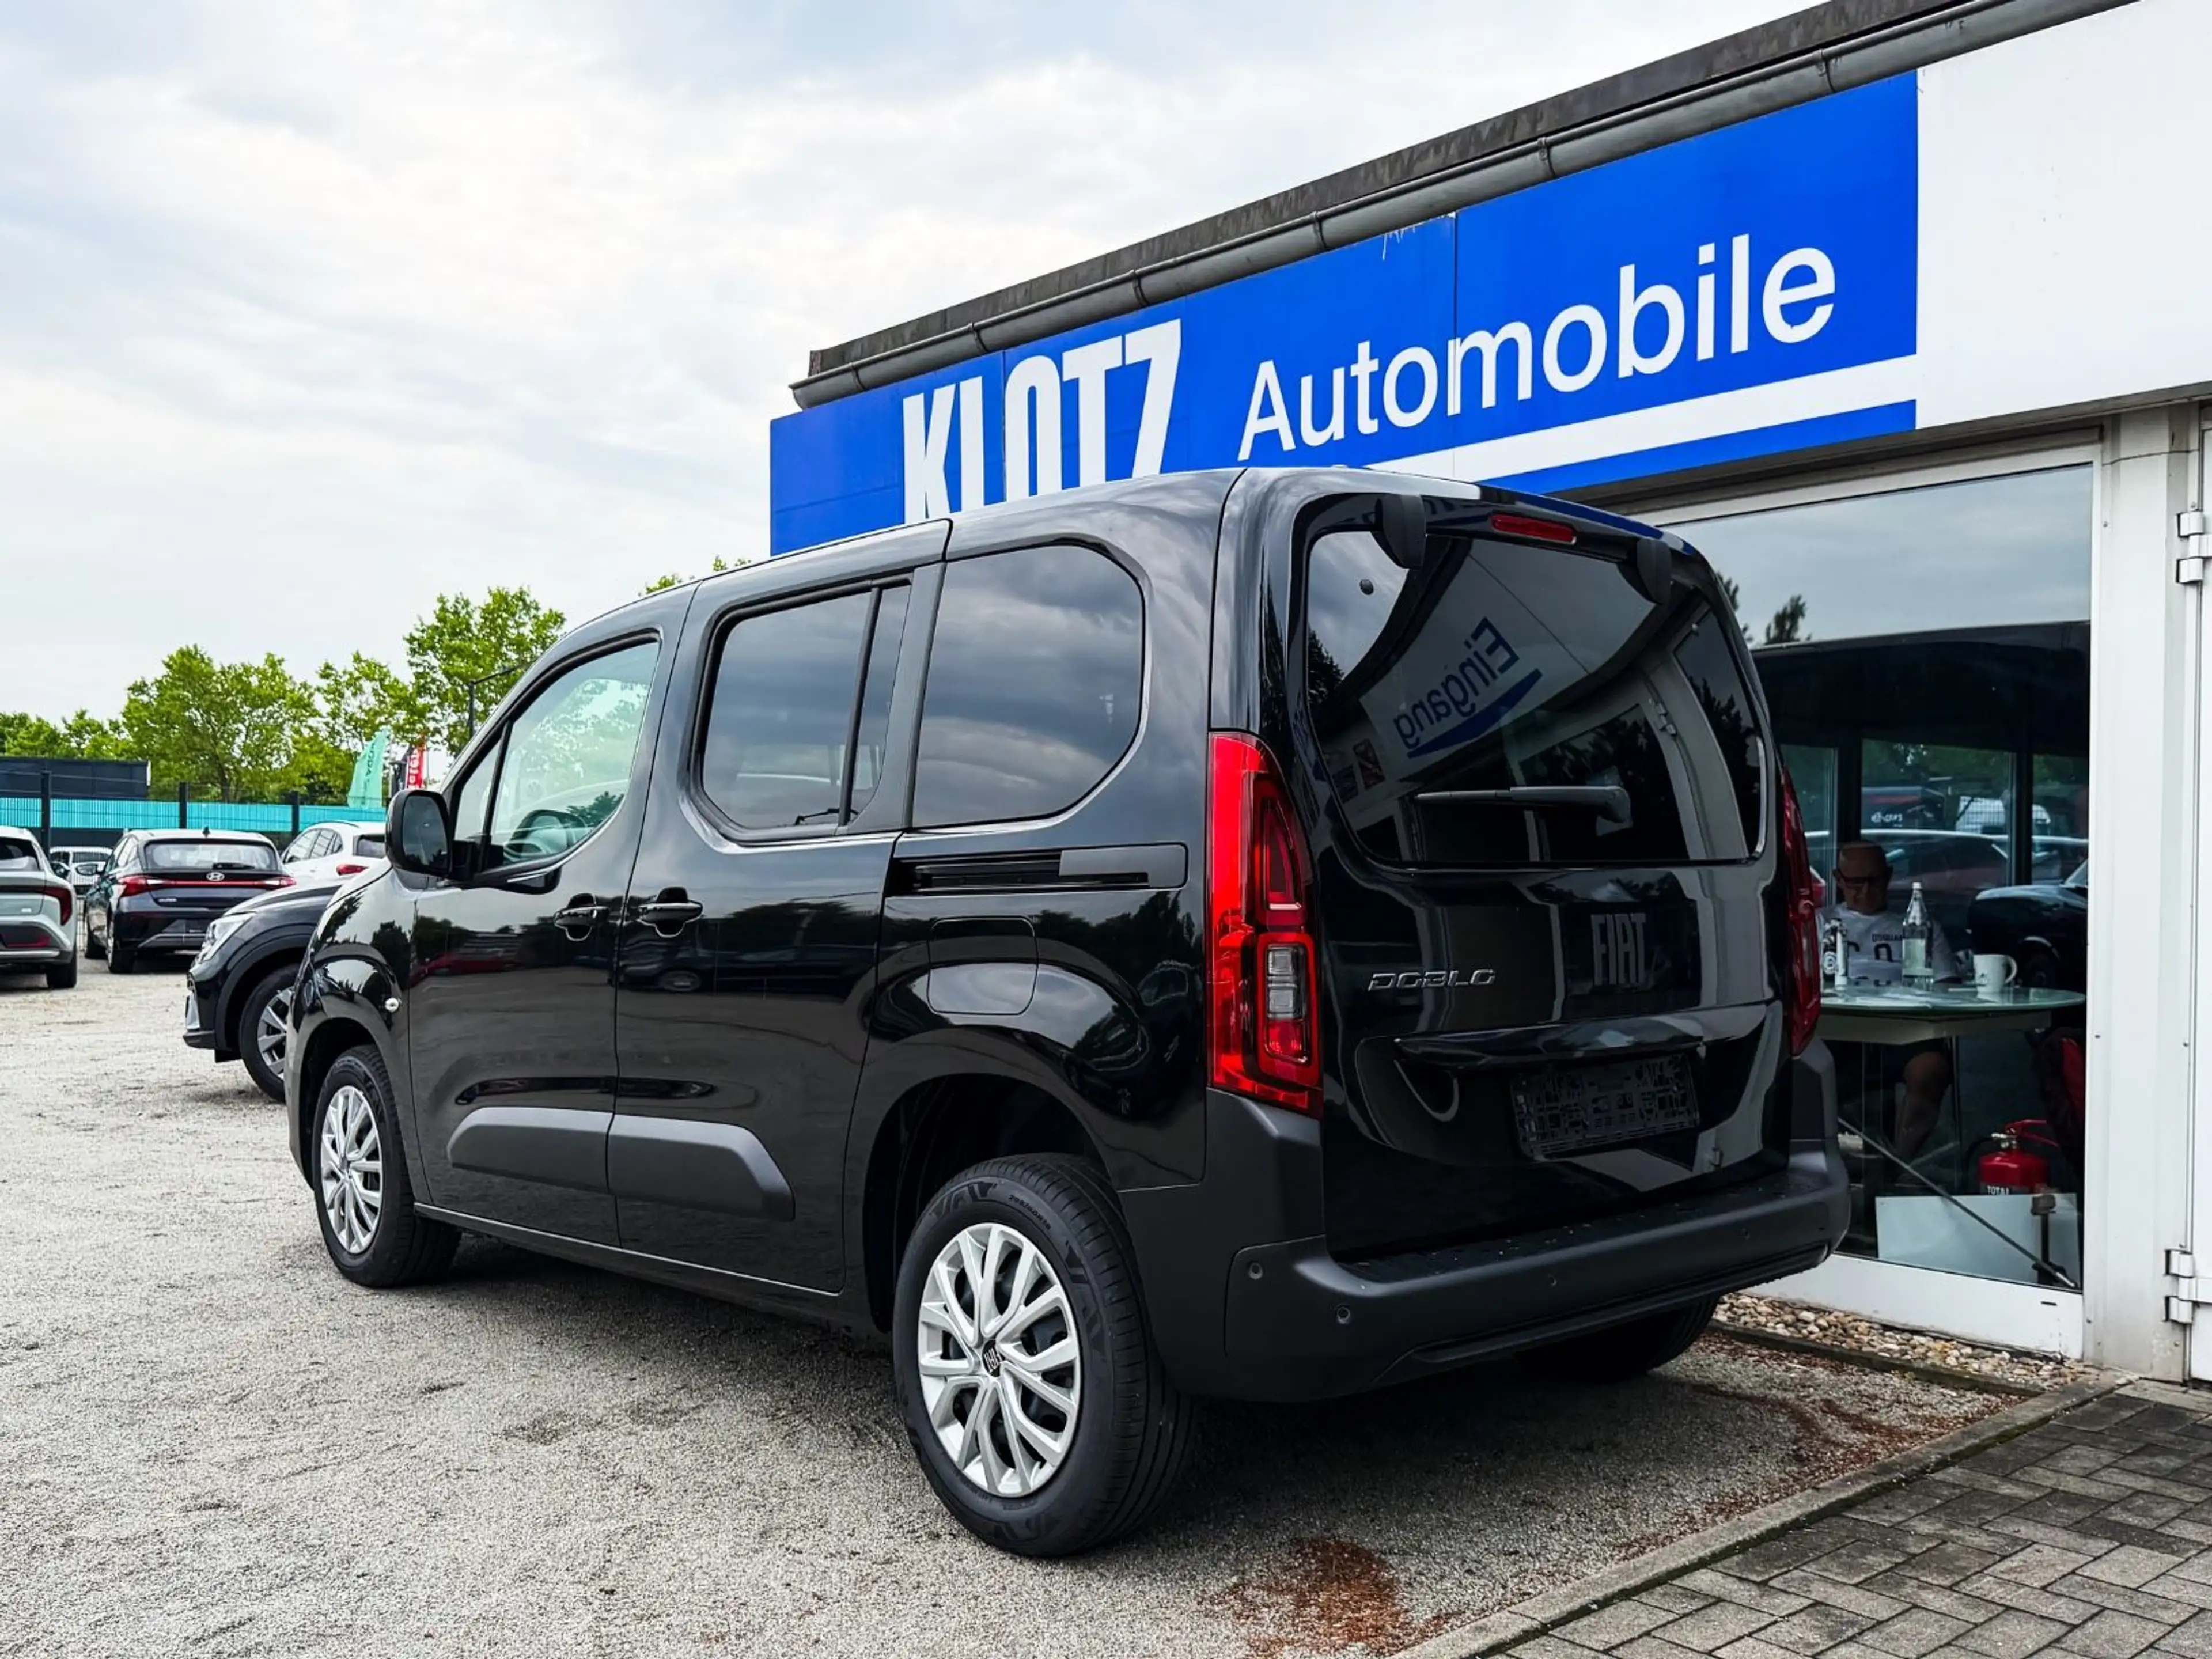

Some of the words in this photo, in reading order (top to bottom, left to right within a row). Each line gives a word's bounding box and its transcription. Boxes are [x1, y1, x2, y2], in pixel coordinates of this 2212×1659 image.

[903, 318, 1181, 525] KLOTZ
[1237, 233, 1836, 461] Automobile
[1590, 913, 1646, 986] FIAT
